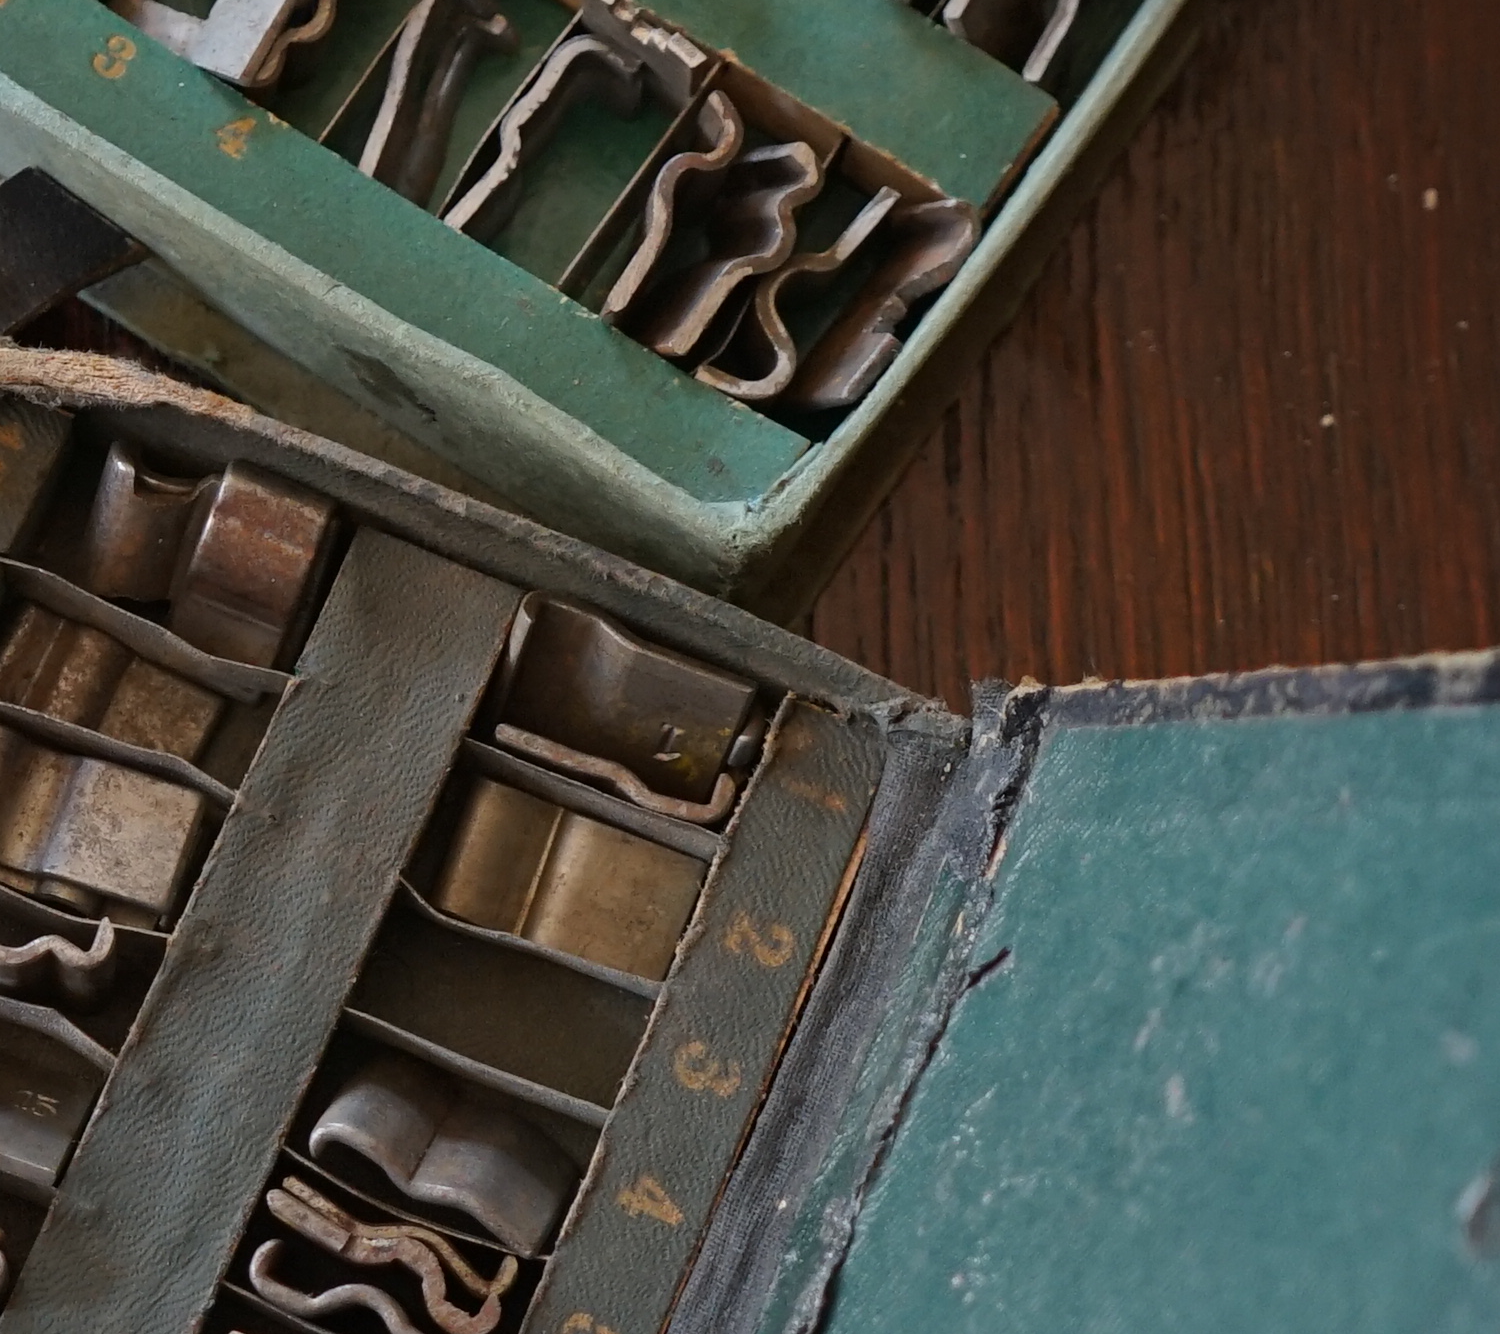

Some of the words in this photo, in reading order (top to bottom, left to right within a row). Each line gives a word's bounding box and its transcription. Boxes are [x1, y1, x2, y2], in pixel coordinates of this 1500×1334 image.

[92, 35, 137, 79] 3
[216, 117, 256, 158] 4
[724, 911, 794, 968] 2
[673, 1041, 742, 1098] 3
[616, 1176, 684, 1225] 4
